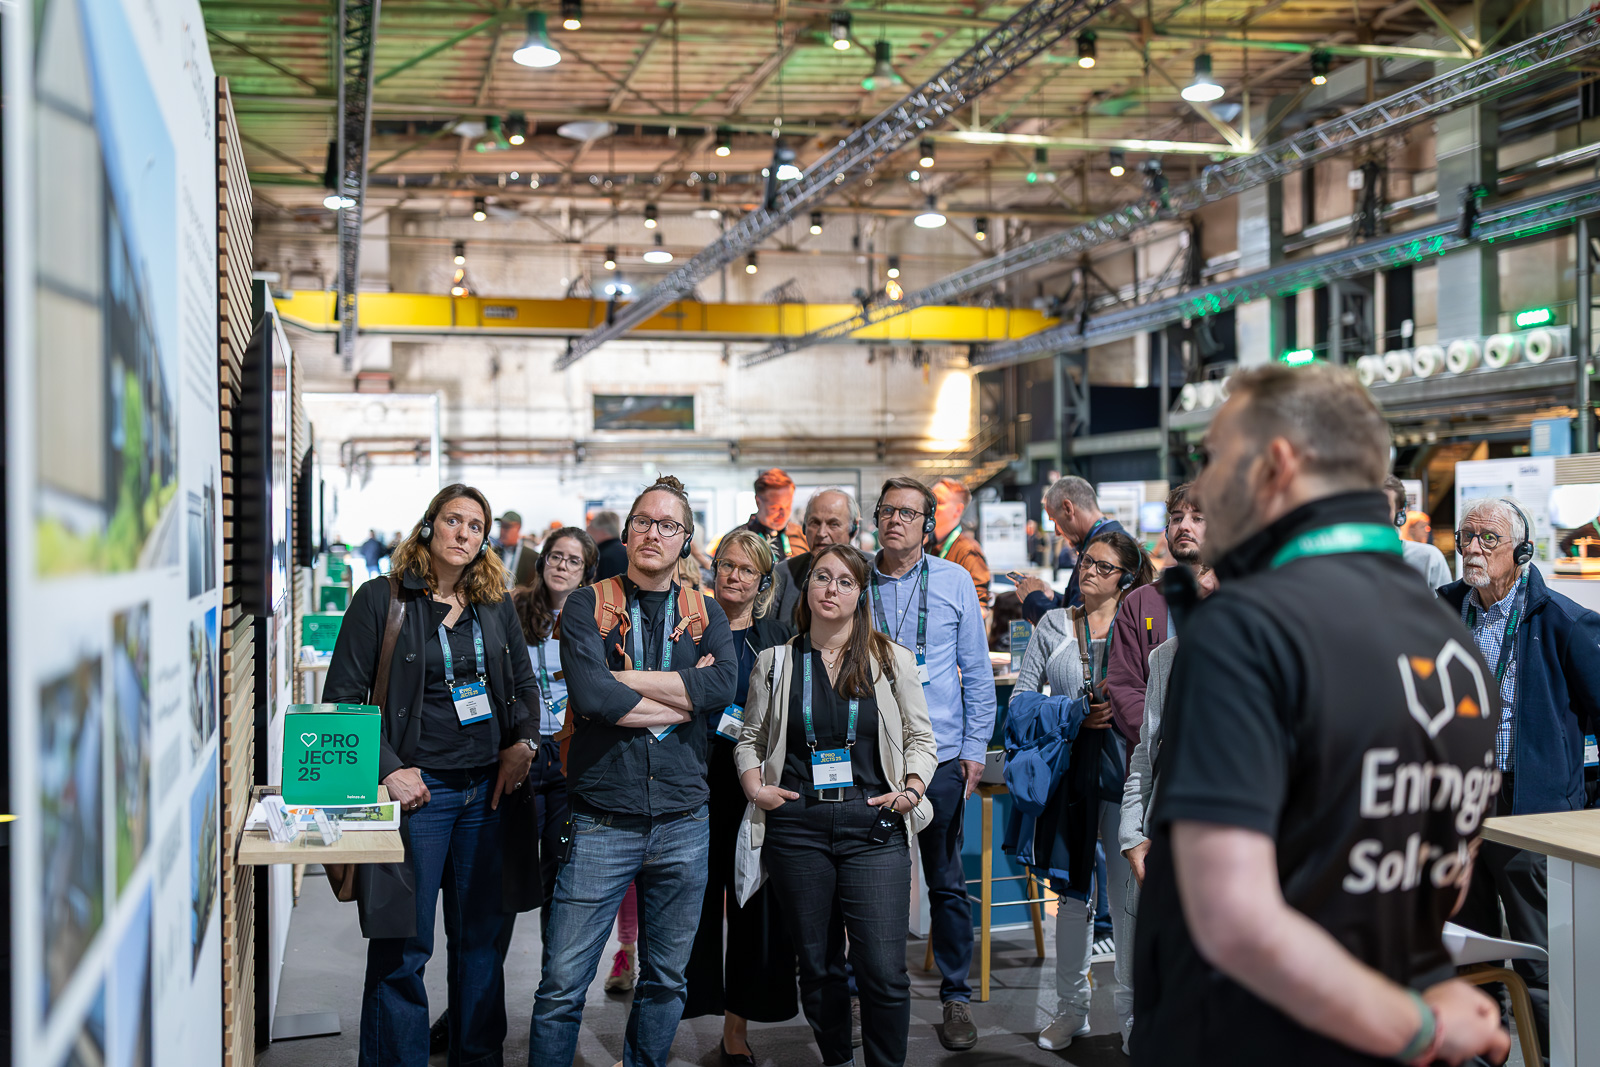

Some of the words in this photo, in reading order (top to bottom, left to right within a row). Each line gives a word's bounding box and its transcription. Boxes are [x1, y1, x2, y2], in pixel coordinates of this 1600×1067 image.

[1509, 609, 1519, 630] Heinze
[849, 710, 857, 729] Heinze
[320, 733, 360, 748] PRO
[298, 750, 358, 765] JECTS
[297, 767, 321, 782] 25
